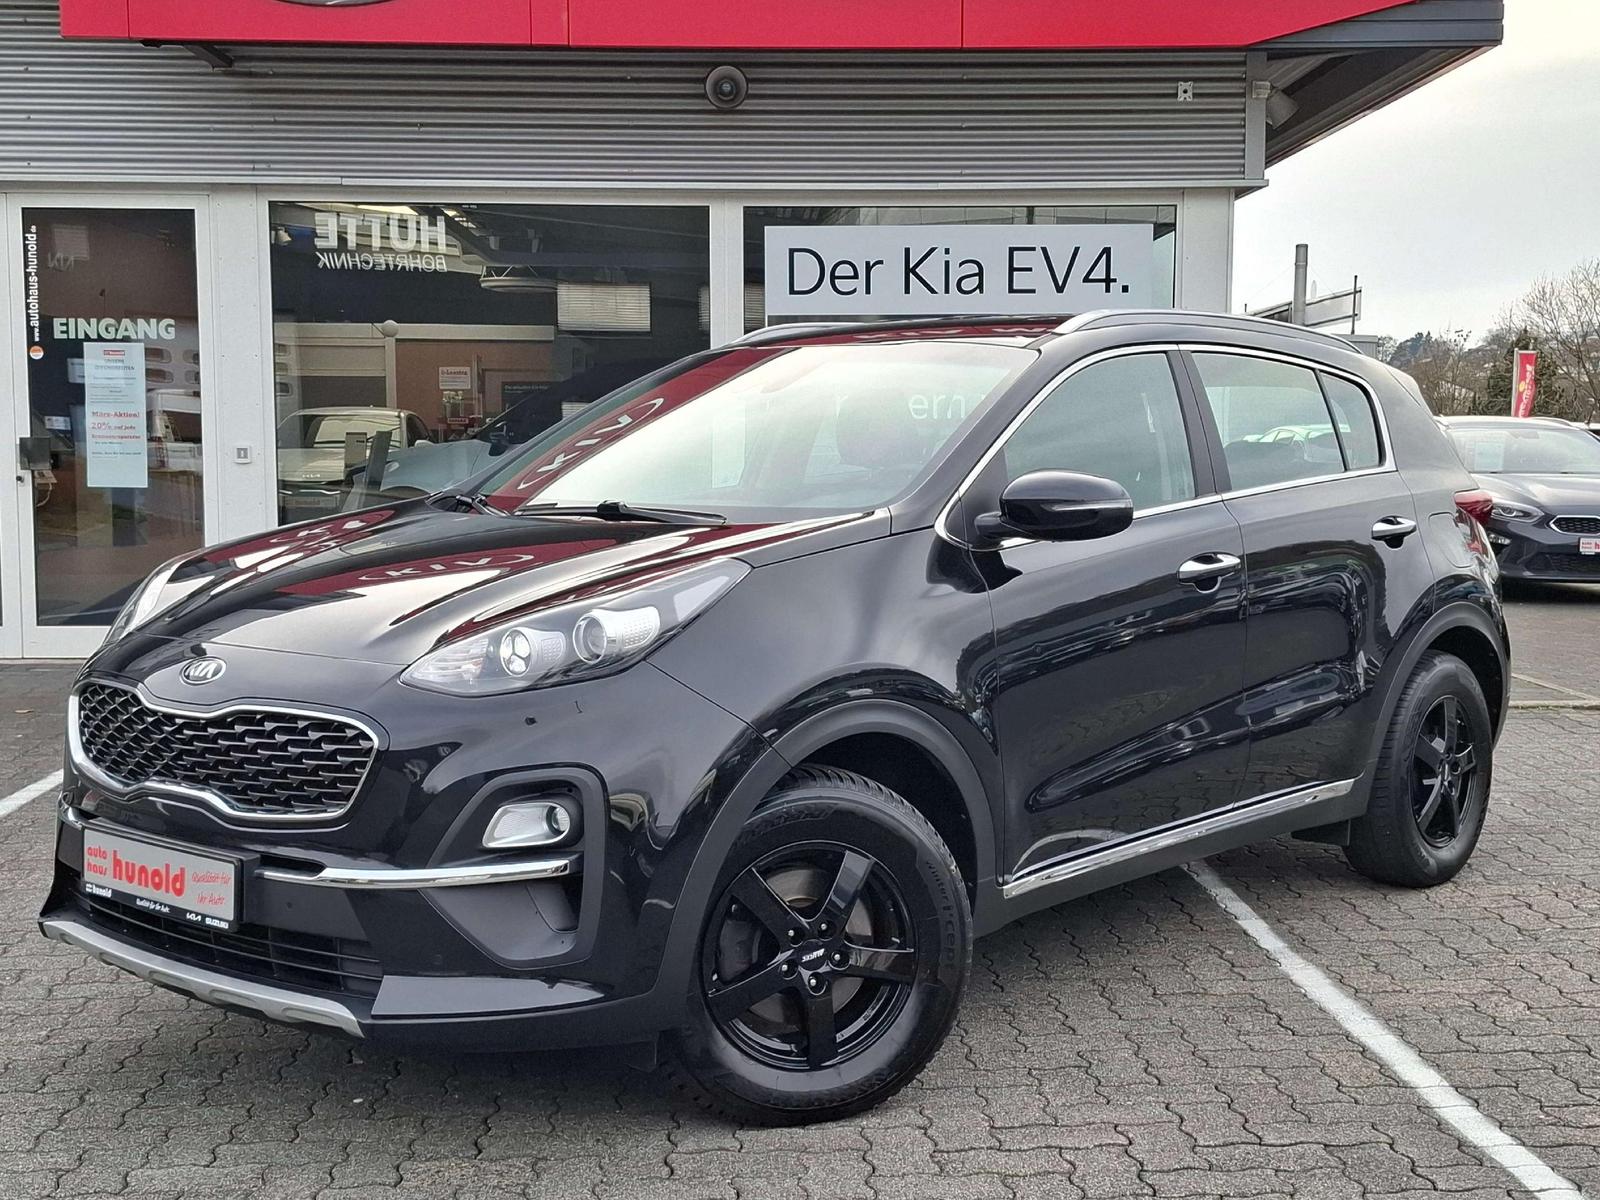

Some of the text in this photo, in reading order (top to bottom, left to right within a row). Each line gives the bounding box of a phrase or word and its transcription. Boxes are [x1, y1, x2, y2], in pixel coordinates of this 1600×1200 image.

[787, 245, 1130, 296] Der Kia EV4.
[53, 317, 176, 340] EINGANG
[184, 661, 218, 679] KIA
[87, 845, 107, 861] auto
[87, 859, 108, 877] haus
[112, 850, 186, 897] hunold
